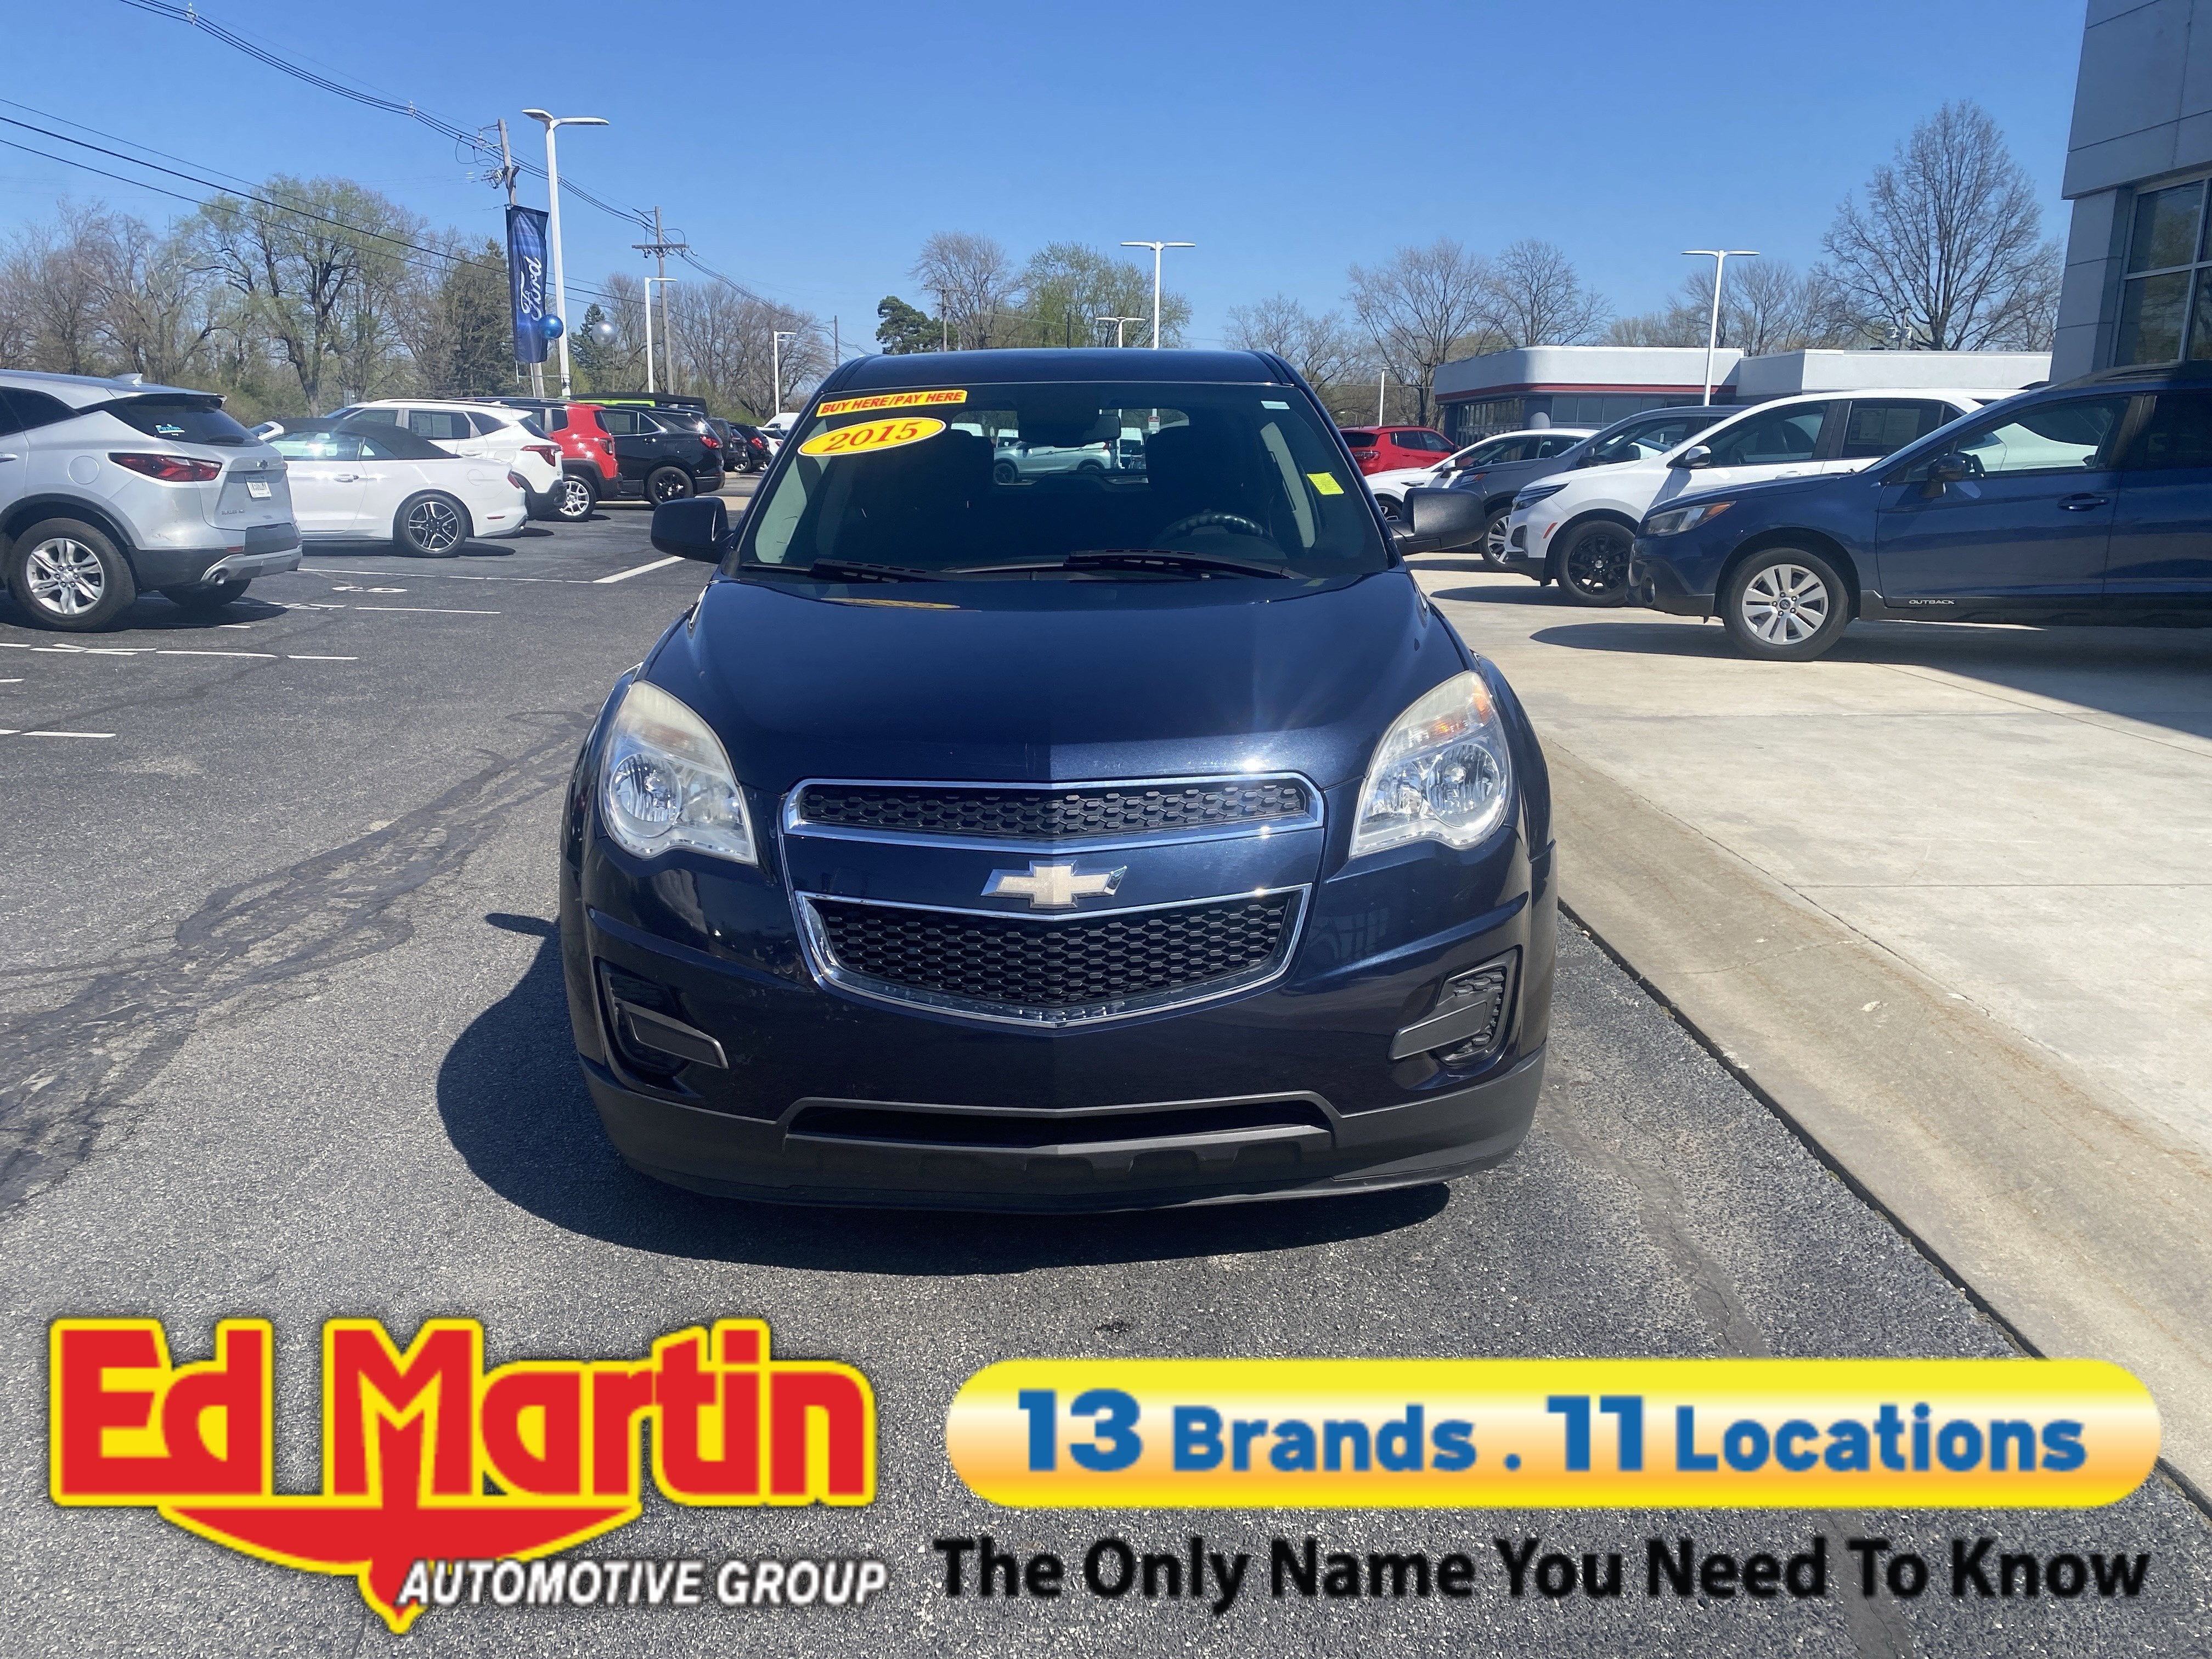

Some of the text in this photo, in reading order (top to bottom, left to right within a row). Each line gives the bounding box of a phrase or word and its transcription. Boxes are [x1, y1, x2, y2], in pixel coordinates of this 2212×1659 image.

[520, 255, 542, 321] Ford
[820, 392, 964, 414] BUY HERE/PAY HERE
[822, 421, 922, 452] 2015
